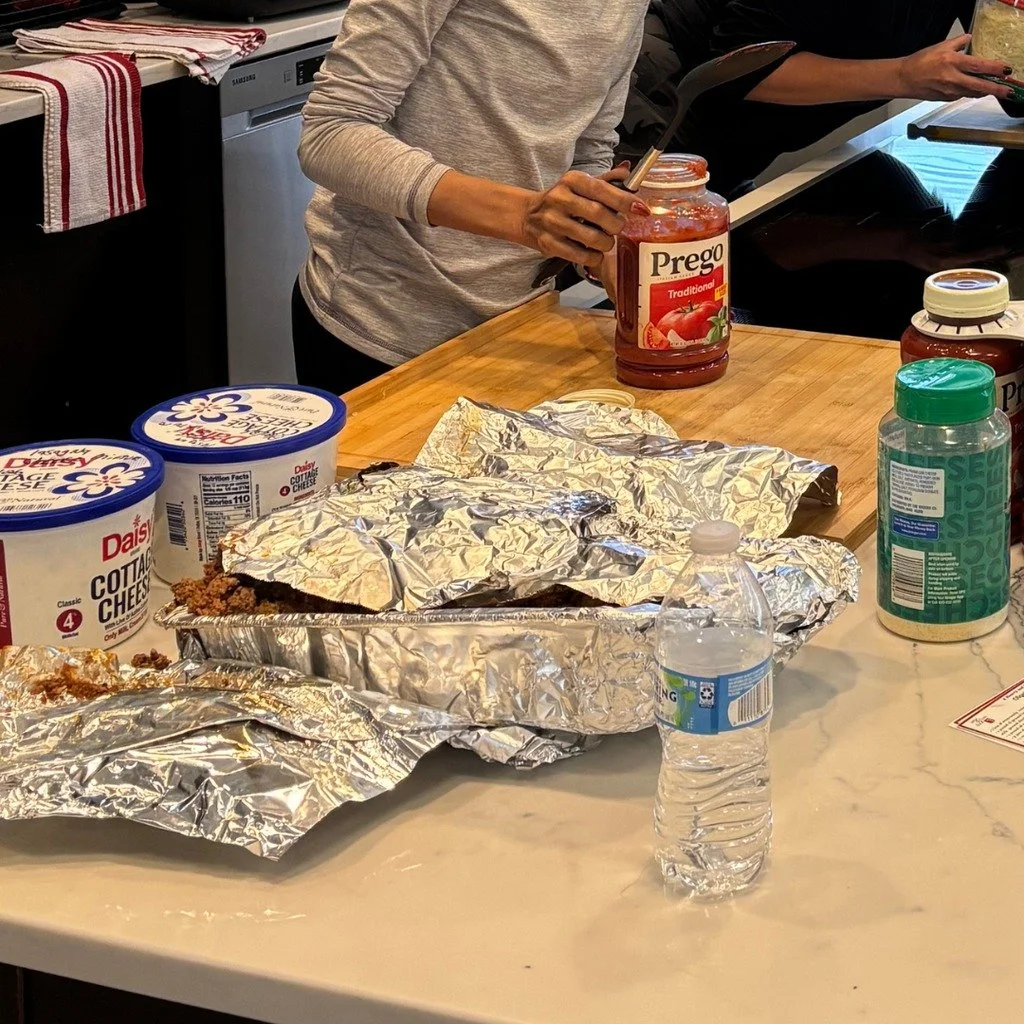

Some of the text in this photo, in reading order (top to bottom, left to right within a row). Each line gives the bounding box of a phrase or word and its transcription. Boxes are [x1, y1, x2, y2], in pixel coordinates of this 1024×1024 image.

[650, 244, 724, 276] Prego
[668, 278, 715, 299] Traditional
[290, 467, 319, 486] COTTAGE
[294, 461, 316, 475] Daisy
[292, 477, 317, 494] CHEESE
[233, 494, 250, 504] 110
[90, 547, 151, 600] COTTAG
[57, 597, 82, 609] Classic
[104, 632, 118, 642] Only
